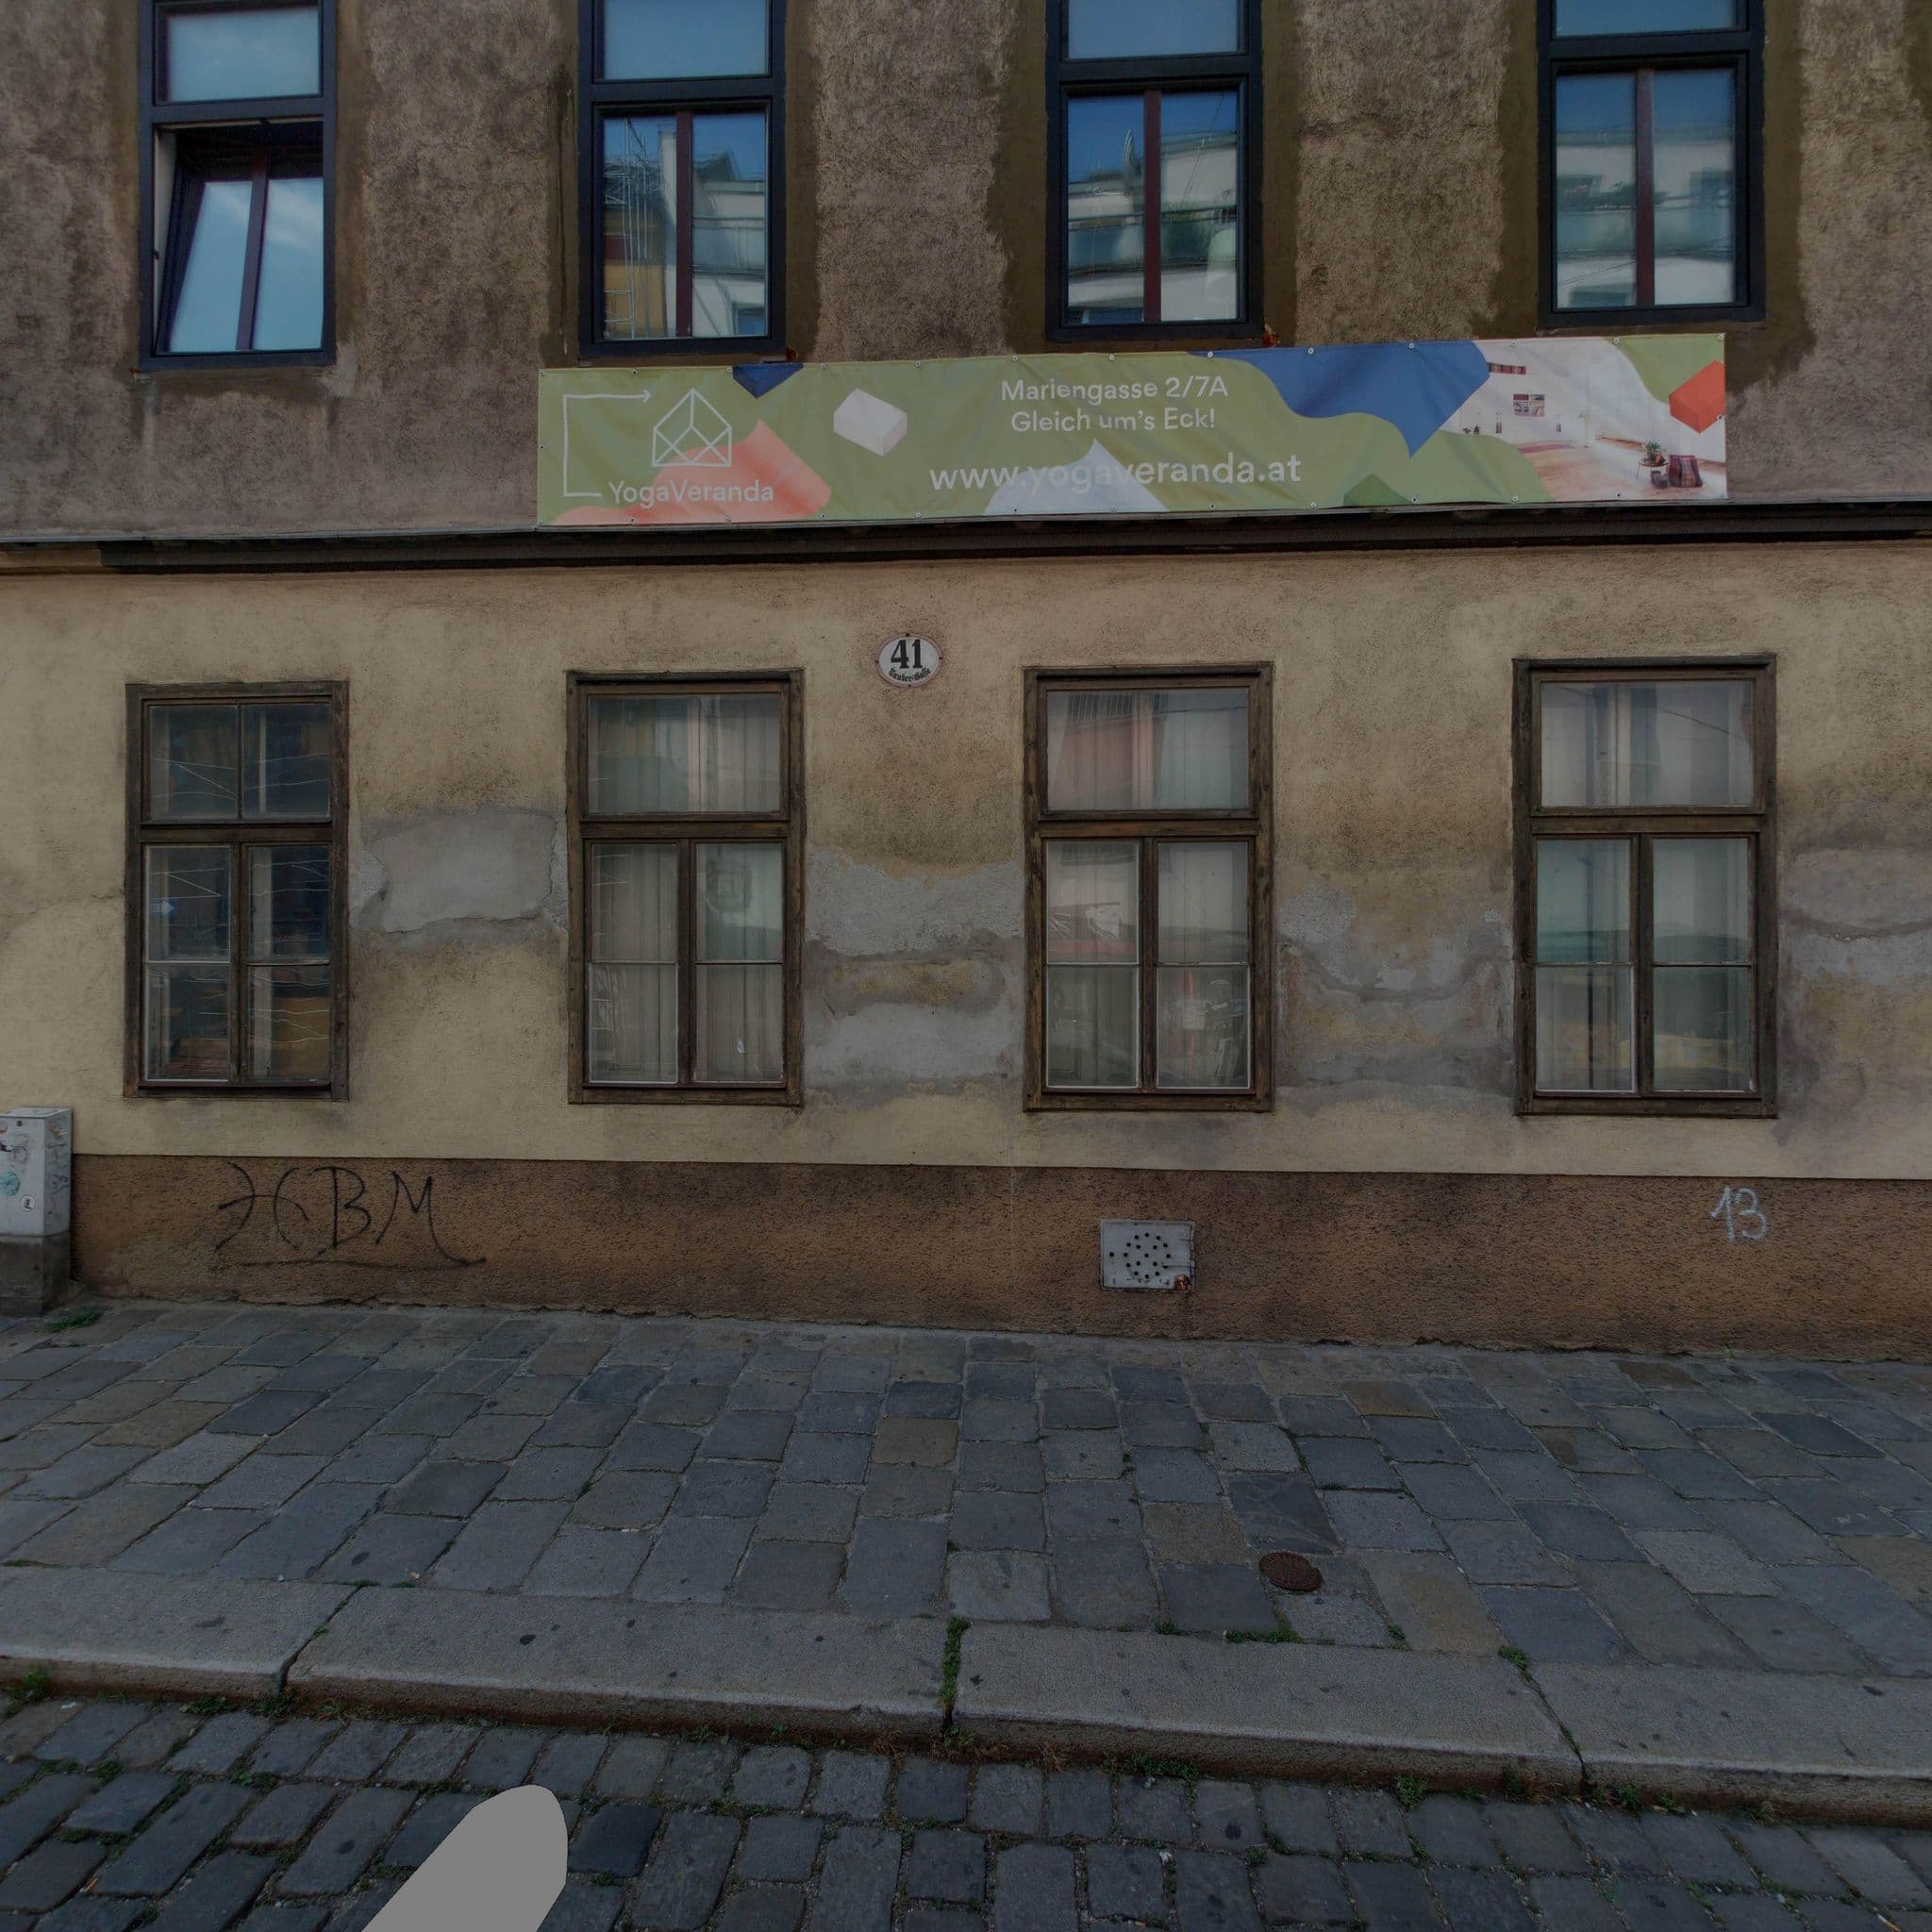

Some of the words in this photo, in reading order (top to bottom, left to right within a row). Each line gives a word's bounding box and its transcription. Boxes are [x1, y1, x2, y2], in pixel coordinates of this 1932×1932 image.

[1001, 378, 1158, 406] Mariengasse
[1164, 375, 1229, 398] 2/7A
[1010, 408, 1091, 432] Gleich
[1163, 408, 1216, 430] Eck!
[928, 454, 1302, 495] www.yogaveranda.at
[608, 478, 774, 509] YogaVeranda
[891, 639, 923, 669] 41
